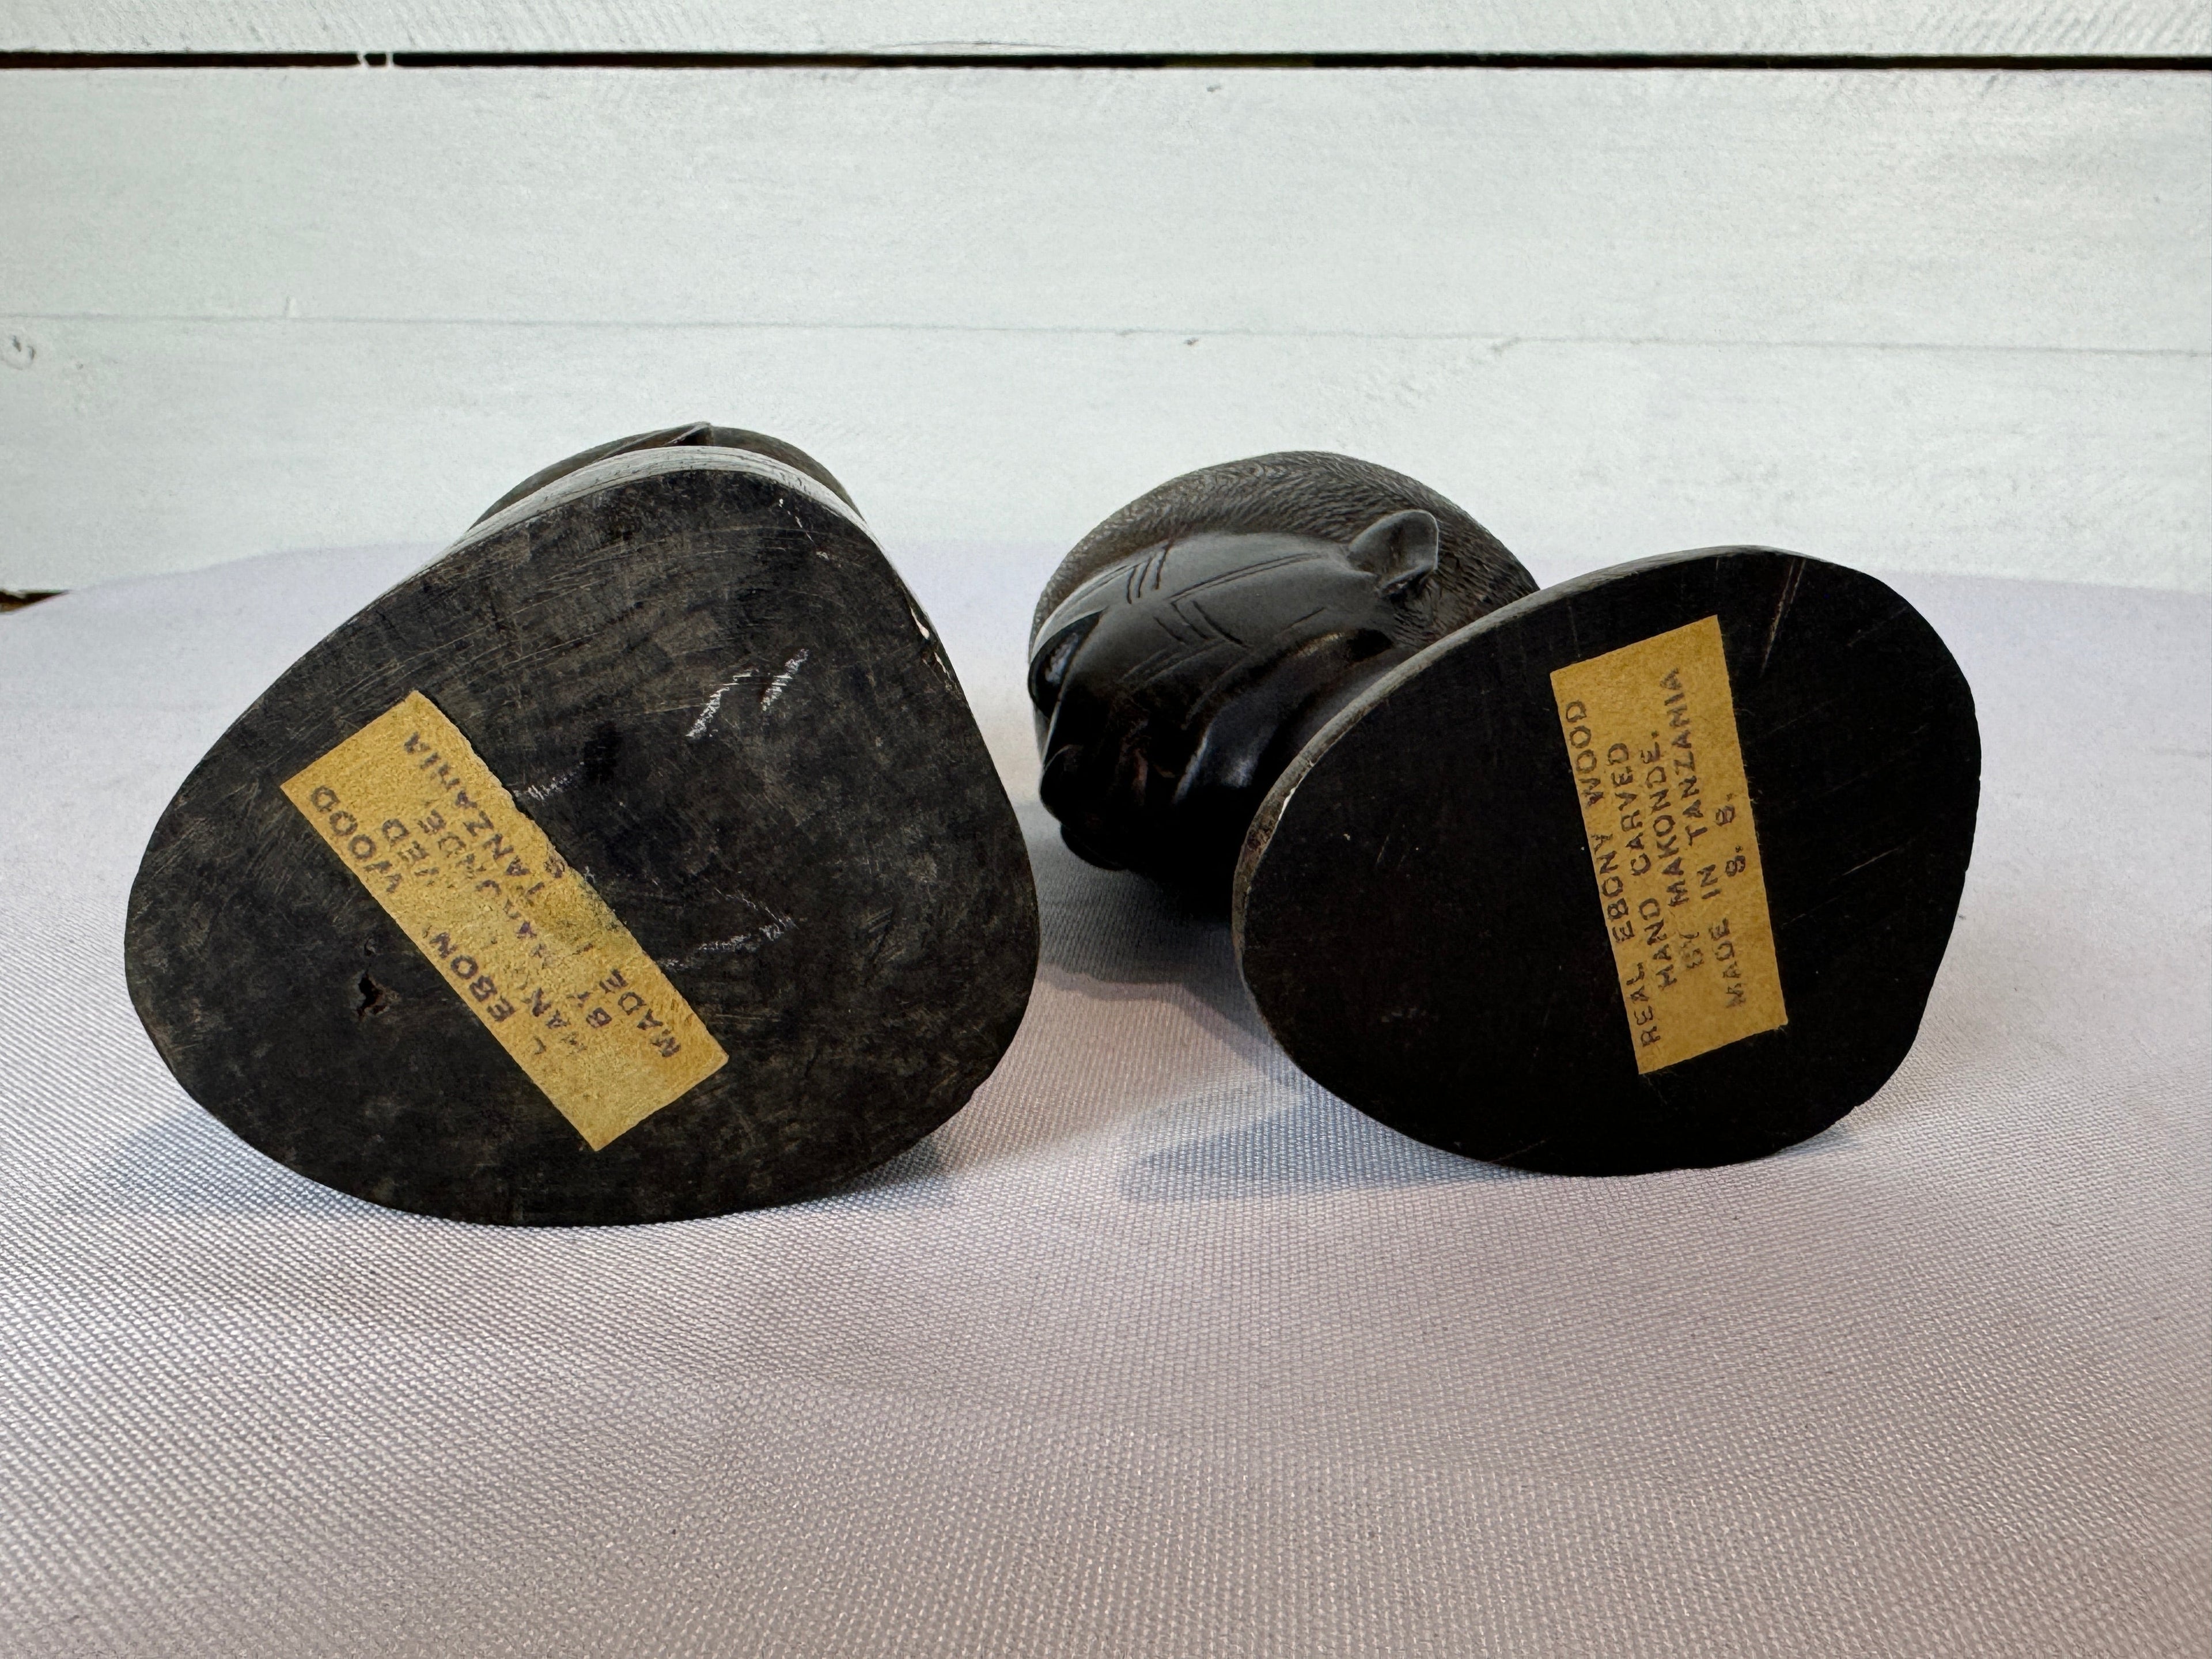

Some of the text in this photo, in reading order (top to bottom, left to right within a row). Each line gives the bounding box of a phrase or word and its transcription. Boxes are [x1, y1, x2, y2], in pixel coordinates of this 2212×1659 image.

[309, 784, 403, 895] WOOD
[1605, 741, 1679, 992] HAND CARVED
[1638, 729, 1691, 908] MAKONDE.
[1564, 698, 1661, 1048] REAL EBONY WOOD
[1695, 863, 1722, 901] IN
[565, 990, 613, 1029] BY
[597, 967, 682, 1059] MADE
[1707, 916, 1746, 1009] MADE
